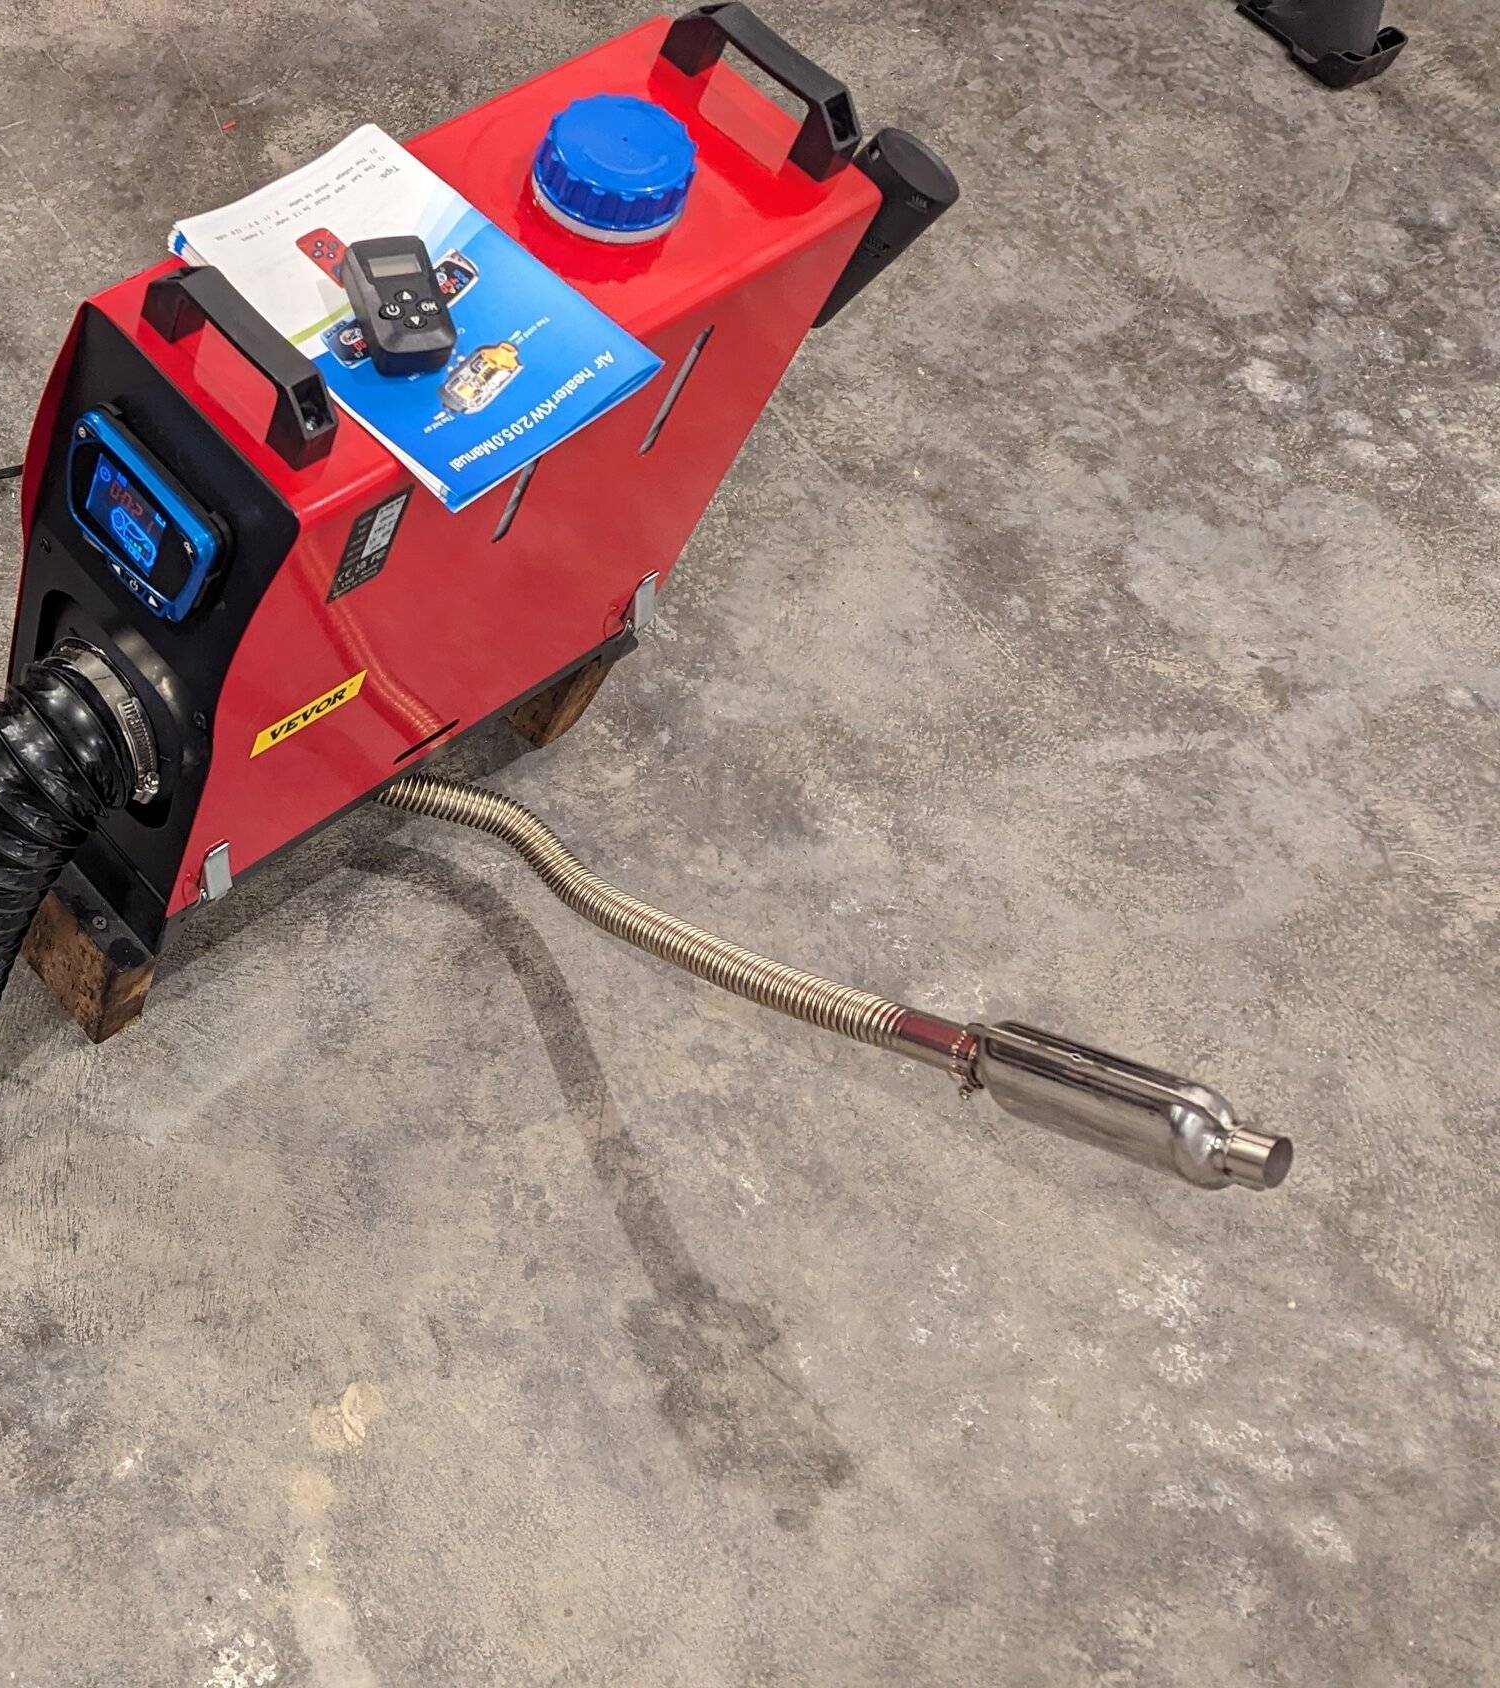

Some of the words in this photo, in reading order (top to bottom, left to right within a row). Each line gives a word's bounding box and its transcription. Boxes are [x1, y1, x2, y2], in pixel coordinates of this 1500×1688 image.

[421, 300, 438, 312] OK
[593, 349, 615, 370] Air
[183, 541, 194, 554] OK
[270, 687, 347, 741] VEVOR
